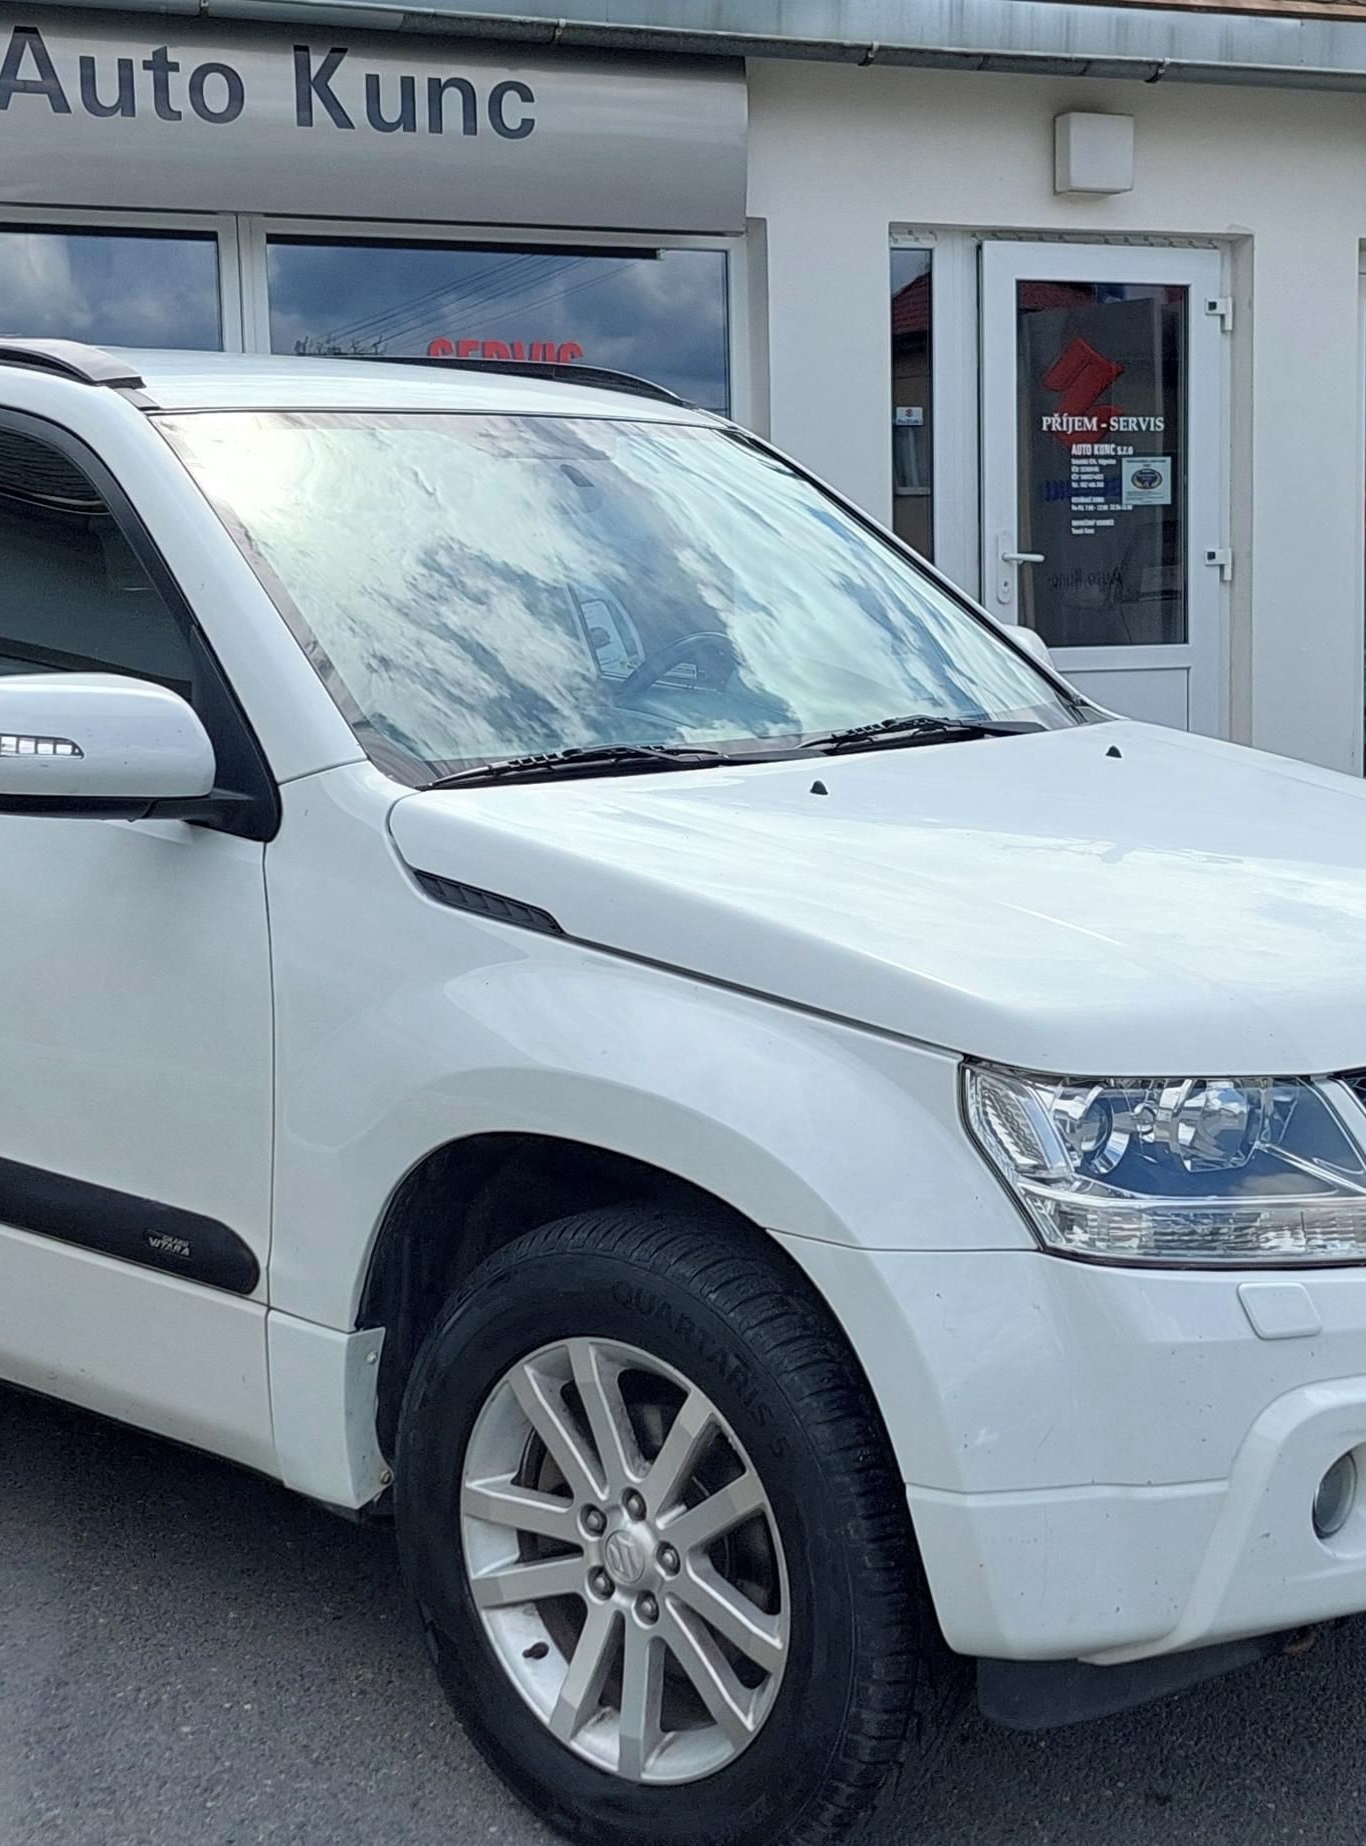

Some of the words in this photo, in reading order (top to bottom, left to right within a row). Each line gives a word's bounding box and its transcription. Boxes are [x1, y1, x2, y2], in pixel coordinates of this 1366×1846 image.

[293, 44, 536, 140] Kunc
[1041, 413, 1098, 434] PŘÍJEM
[1109, 416, 1165, 432] SERVIS
[1071, 443, 1092, 456] AUTO
[1093, 443, 1116, 456] KUNC
[148, 1237, 190, 1256] VITARA
